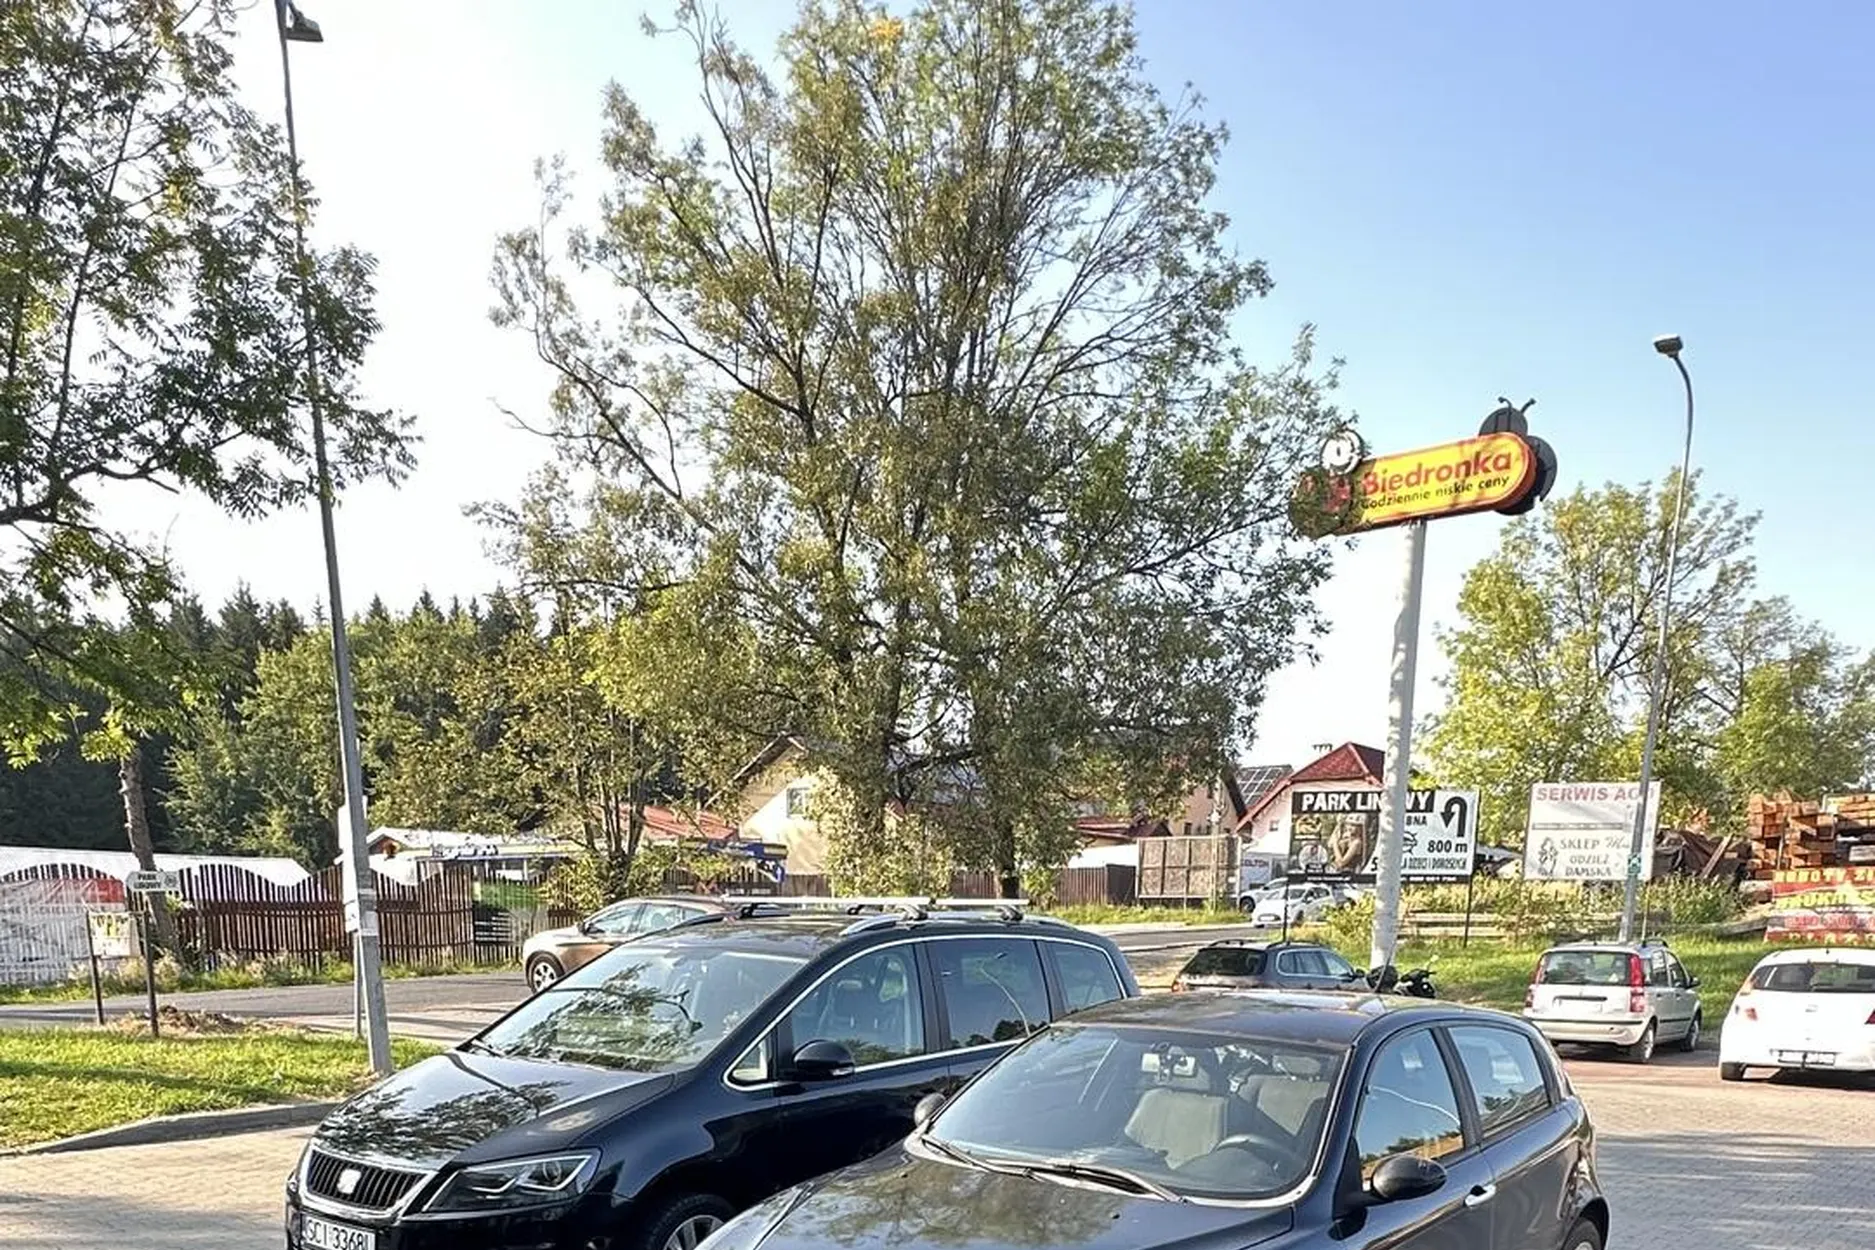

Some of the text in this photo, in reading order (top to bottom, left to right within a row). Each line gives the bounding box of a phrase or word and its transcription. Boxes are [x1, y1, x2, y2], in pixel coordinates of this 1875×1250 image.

[1362, 450, 1512, 496] Biedronka
[1436, 478, 1474, 498] niskie
[1478, 475, 1511, 492] ceny
[1302, 793, 1352, 812] PARK
[1536, 787, 1609, 802] SERWIS
[1428, 840, 1468, 853] 800 m
[1560, 839, 1600, 850] SKLEP
